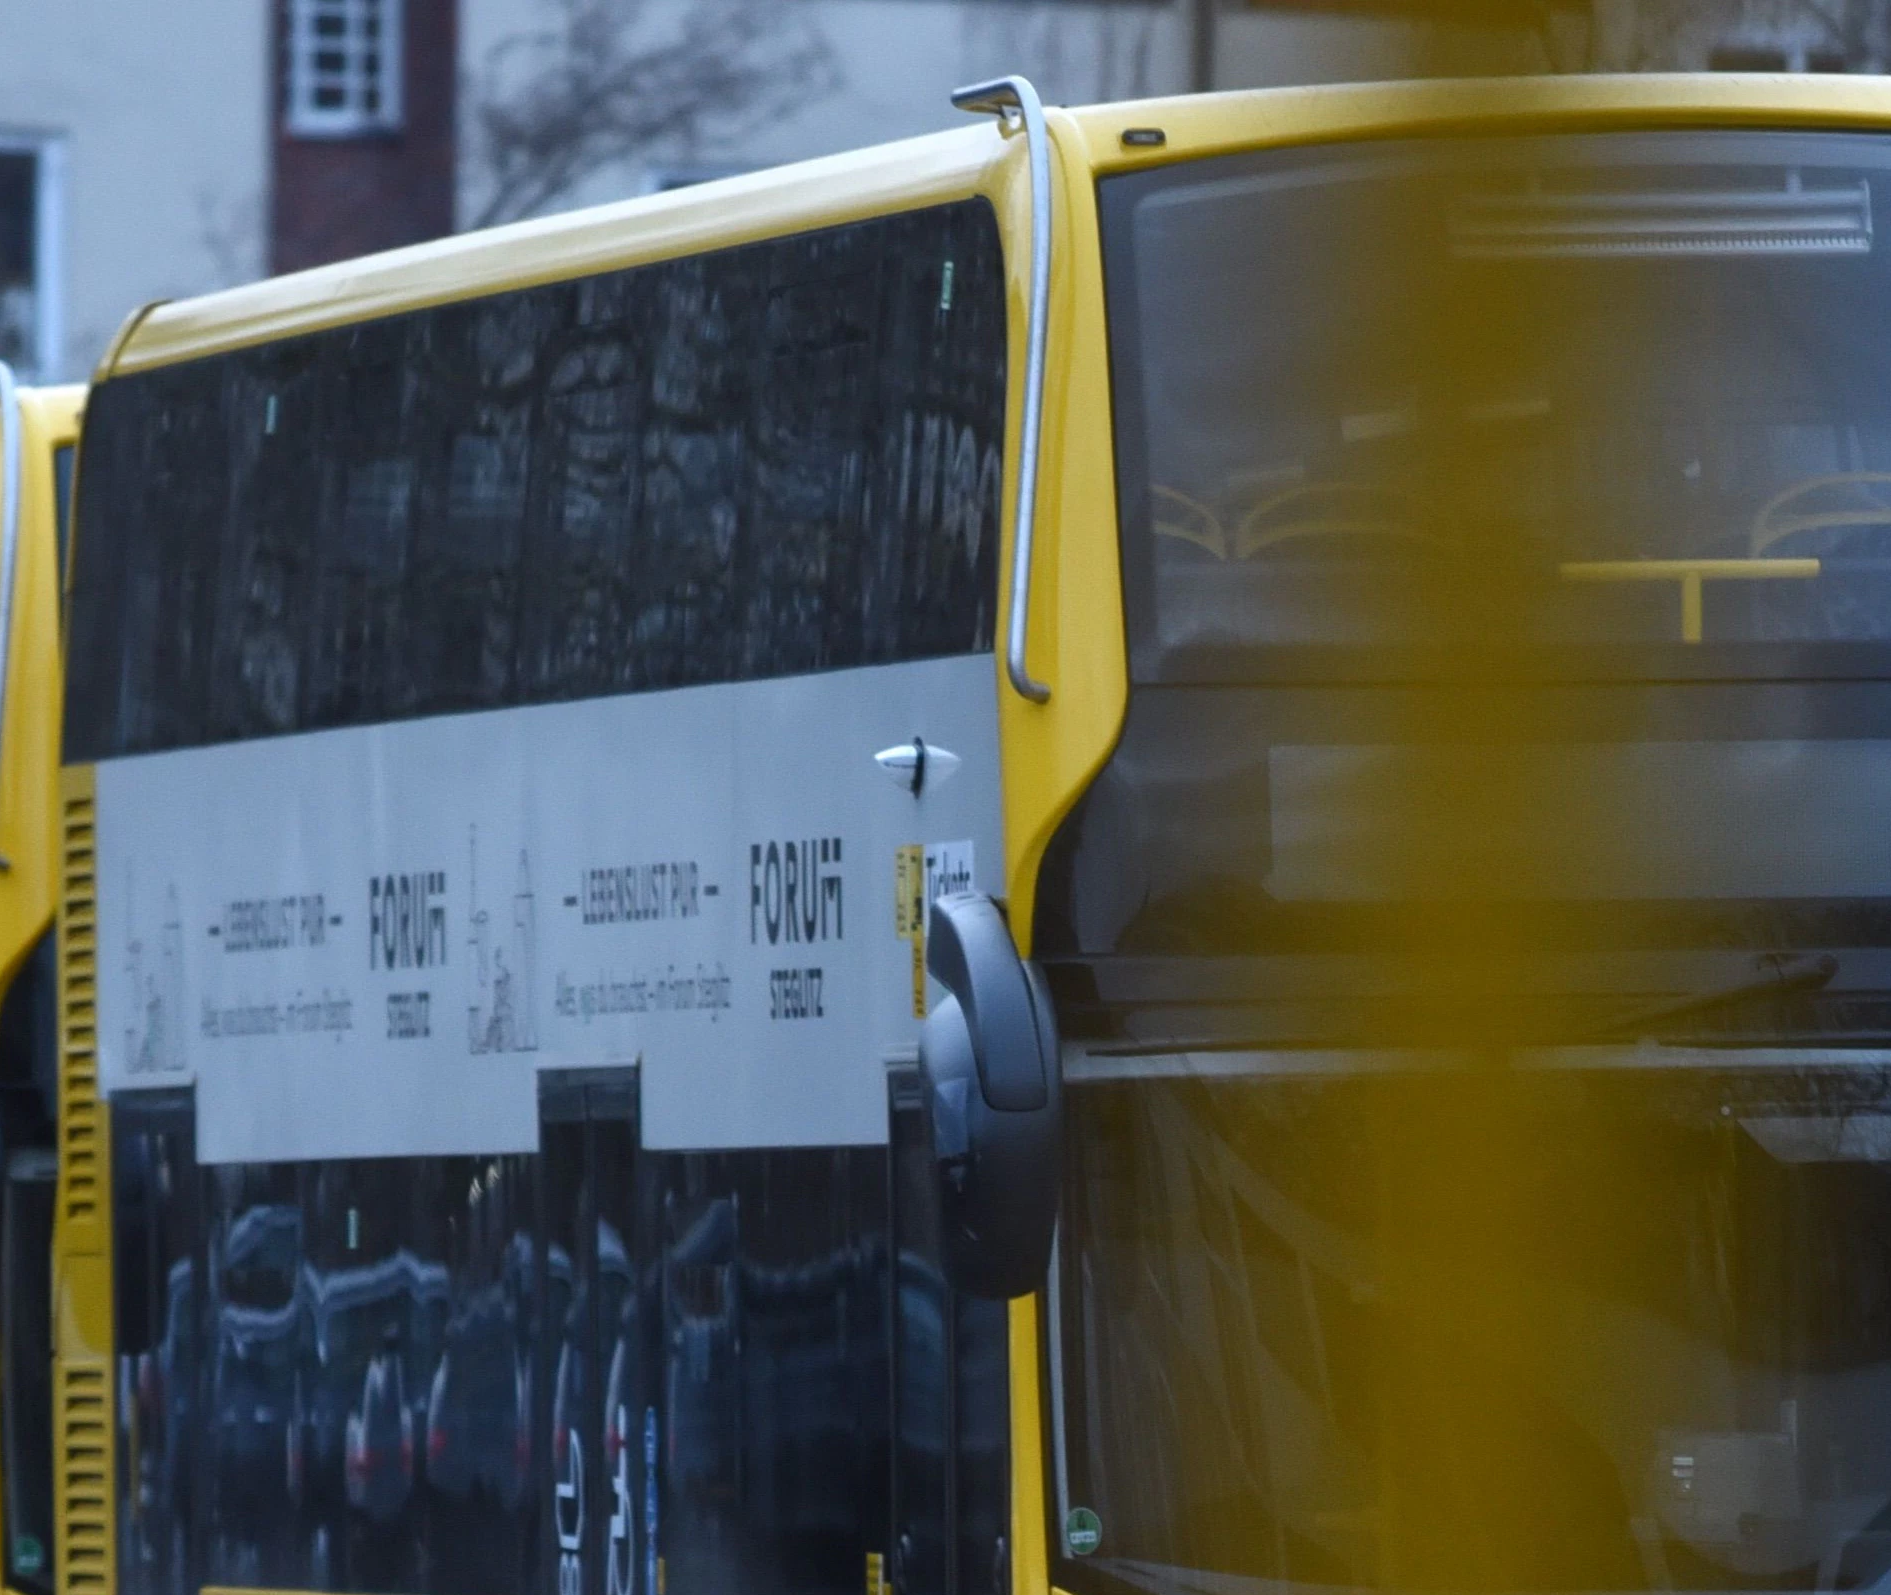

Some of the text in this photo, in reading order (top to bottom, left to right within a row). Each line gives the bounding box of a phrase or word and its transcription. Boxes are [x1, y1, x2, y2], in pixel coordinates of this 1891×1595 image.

[369, 871, 446, 971] FORUM
[751, 837, 843, 945] FORUM
[770, 967, 824, 1019] STEGLITZ
